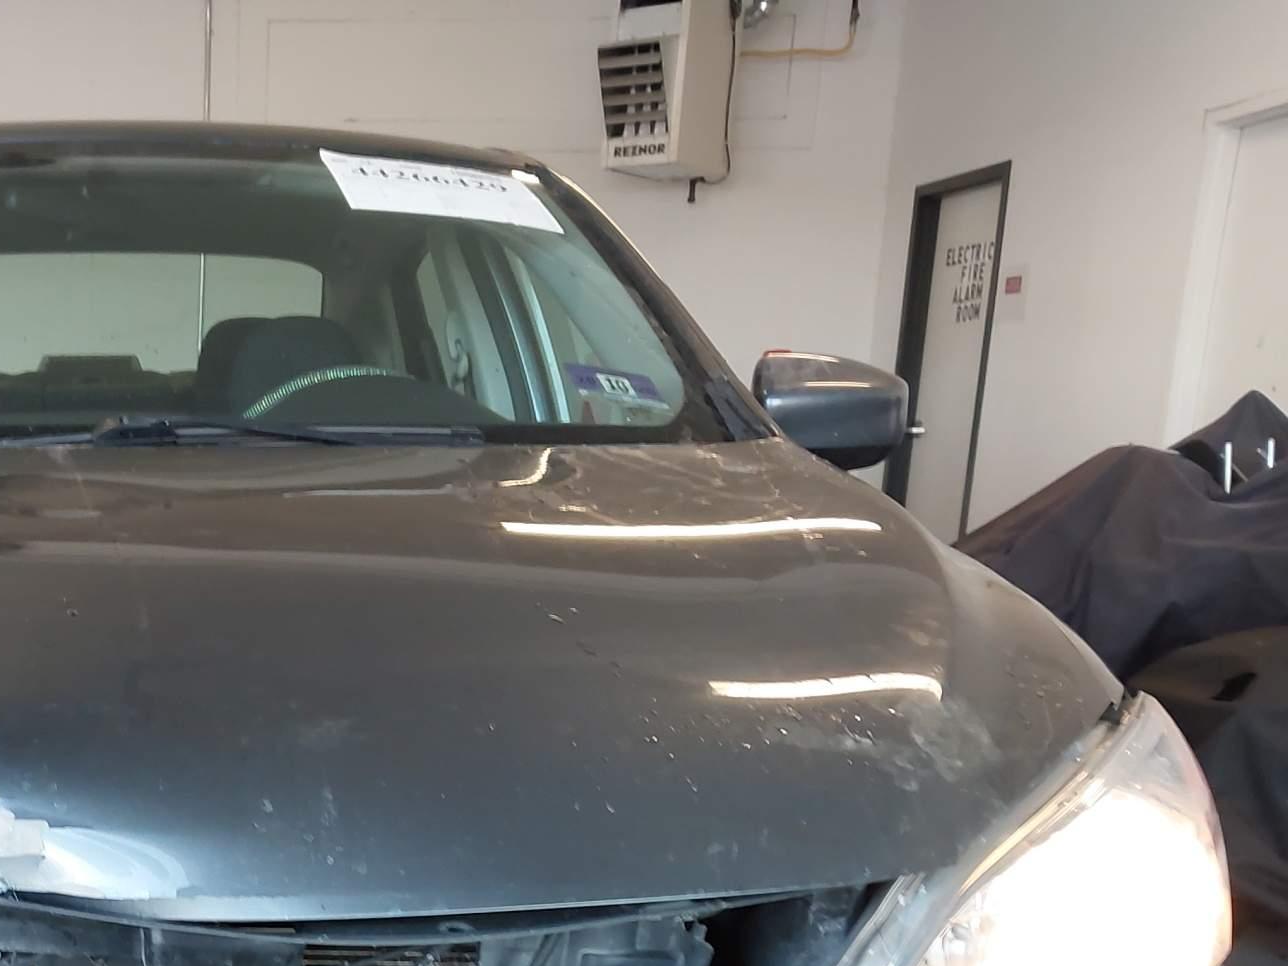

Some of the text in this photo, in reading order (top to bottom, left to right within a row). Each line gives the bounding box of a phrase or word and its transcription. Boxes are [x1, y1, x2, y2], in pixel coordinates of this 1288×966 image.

[352, 167, 508, 192] 44266429
[946, 241, 994, 267] ELECTRIC
[961, 262, 985, 283] FIRE
[953, 282, 983, 304] ALARM
[955, 303, 981, 323] ROOM
